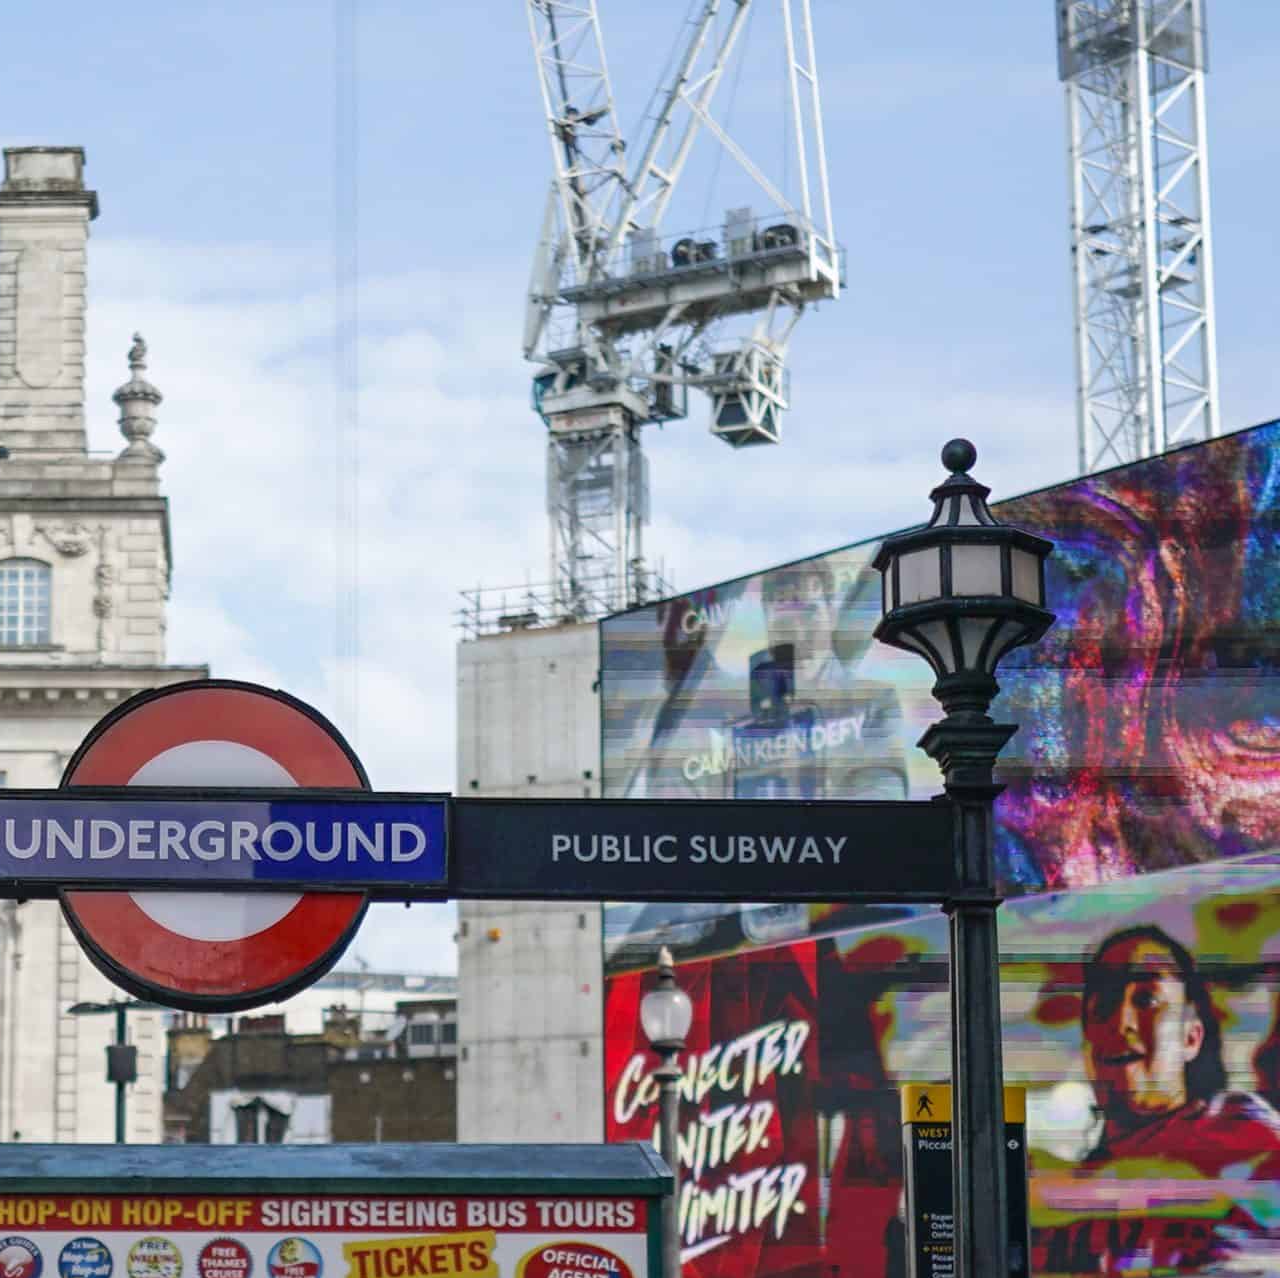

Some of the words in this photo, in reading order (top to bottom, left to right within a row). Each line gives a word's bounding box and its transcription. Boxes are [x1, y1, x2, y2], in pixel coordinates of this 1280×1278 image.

[811, 712, 865, 751] DEFY
[4, 817, 427, 864] UNDERGROUND
[551, 834, 679, 864] PUBLIC
[689, 834, 849, 865] SUBWAY
[653, 1101, 774, 1182] NITED.
[918, 1128, 949, 1138] WEST
[918, 1139, 953, 1151] Piccad
[122, 1199, 252, 1227] HOP-OFF
[261, 1199, 457, 1228] SIGHTSEEING
[467, 1200, 527, 1228] BUS
[536, 1200, 636, 1228] TOURS
[139, 1239, 169, 1250] FREE
[211, 1247, 238, 1258] FREE
[202, 1258, 248, 1269] THAMES
[542, 1249, 620, 1273] OFFICIAL
[284, 1266, 306, 1276] FREE
